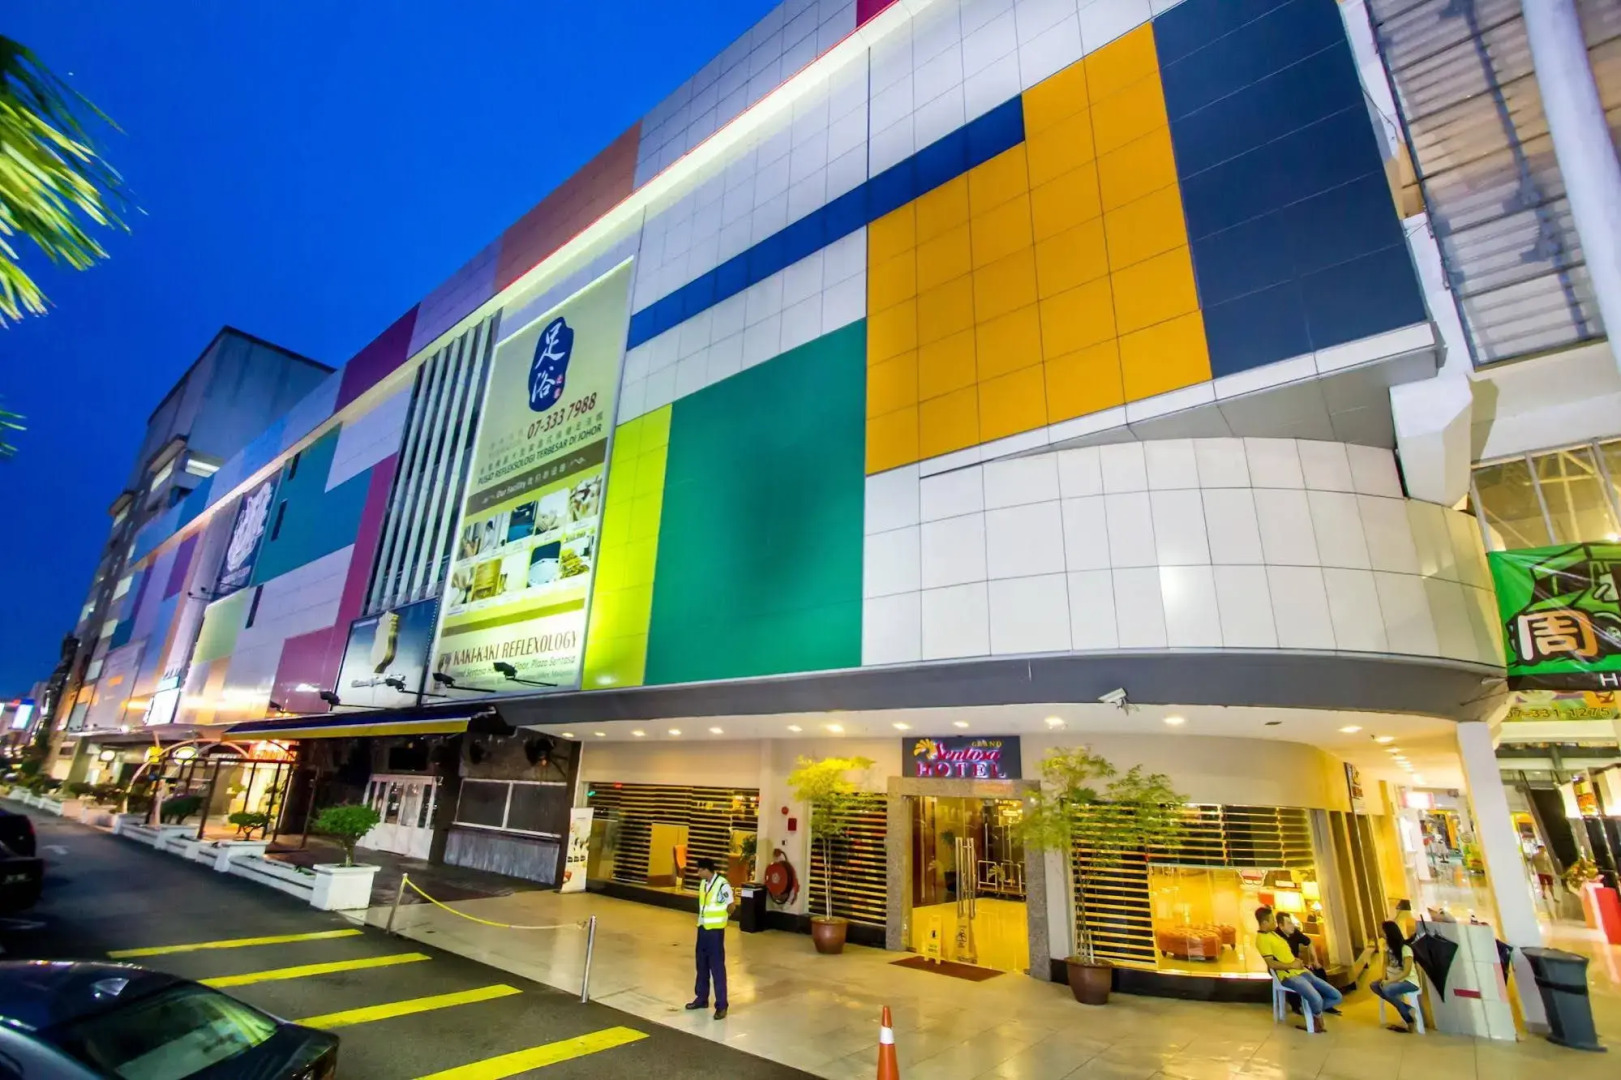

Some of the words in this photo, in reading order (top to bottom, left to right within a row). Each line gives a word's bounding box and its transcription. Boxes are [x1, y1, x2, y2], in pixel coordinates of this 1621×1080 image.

[527, 408, 565, 440] 07-333
[567, 391, 597, 421] 7988
[537, 439, 568, 460] TERBESAR
[569, 434, 578, 446] DI
[578, 423, 602, 441] JOHOR
[453, 643, 500, 666] KAKI-KAKI
[501, 630, 577, 658] REFLEXOLOGY
[1518, 609, 1599, 661] 周
[1568, 706, 1611, 719] 1275
[935, 741, 1001, 762] Sentosa
[971, 740, 1003, 748] GRAND
[916, 761, 1008, 779] HOTEL
